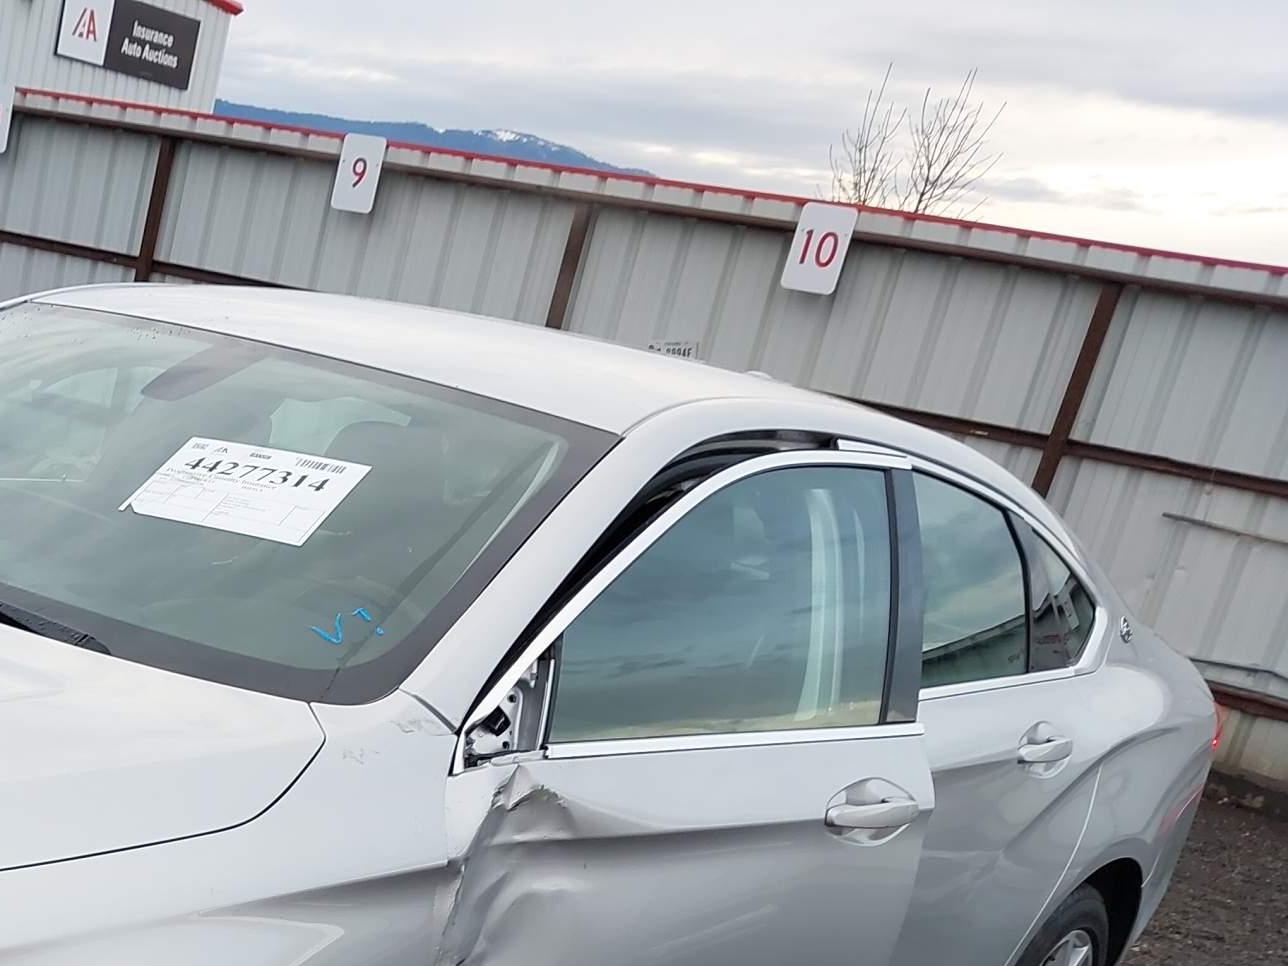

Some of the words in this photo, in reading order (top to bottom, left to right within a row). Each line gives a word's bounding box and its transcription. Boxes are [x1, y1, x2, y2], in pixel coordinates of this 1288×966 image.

[132, 20, 174, 48] Insurance
[121, 37, 142, 56] Auto
[142, 43, 179, 69] Auctions
[352, 157, 367, 188] 9
[799, 229, 839, 268] 10
[184, 456, 331, 492] 44277314
